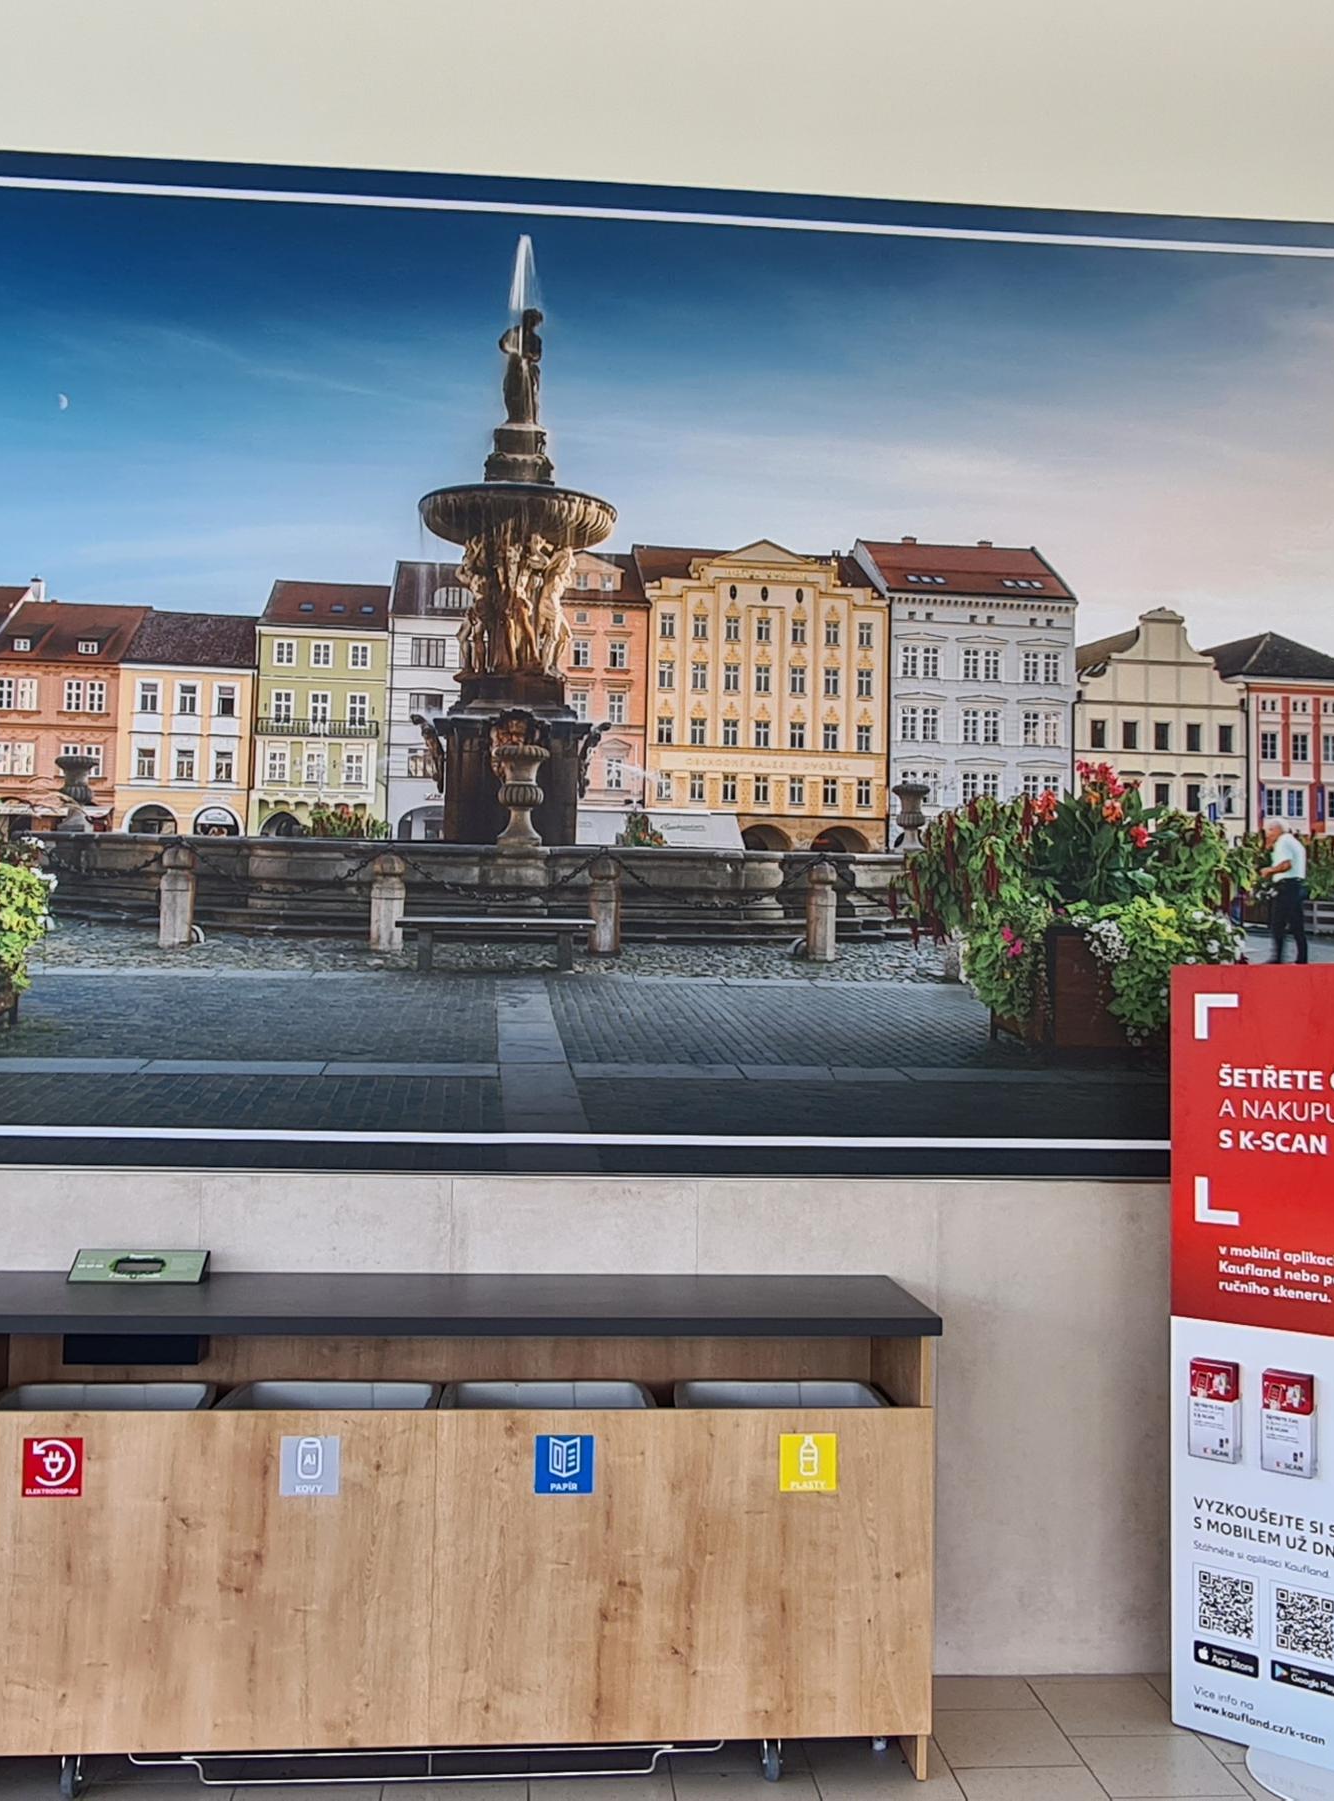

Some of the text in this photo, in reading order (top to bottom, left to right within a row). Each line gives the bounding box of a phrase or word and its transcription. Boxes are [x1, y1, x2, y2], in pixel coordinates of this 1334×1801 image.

[1219, 1063, 1324, 1091] ŠETŘETE
[1219, 1098, 1236, 1118] A
[1219, 1129, 1328, 1155] S K-SCAN
[1219, 1246, 1227, 1255] v
[1230, 1245, 1280, 1261] mobilní
[1218, 1260, 1281, 1279] Kaufland
[1284, 1269, 1319, 1283] nebo
[1219, 1280, 1331, 1303] ručního skeneru.
[295, 1484, 323, 1493] KOVY
[550, 1481, 577, 1491] PAPÍR
[1193, 1496, 1305, 1531] VYZKOUŠEJTE
[1309, 1520, 1323, 1535] SI
[1193, 1516, 1202, 1529] S
[1207, 1519, 1281, 1546] MOBILEM
[1286, 1535, 1307, 1552] UŽ
[1193, 1540, 1235, 1558] Stáhněte
[1237, 1551, 1244, 1559] si
[1247, 1553, 1282, 1568] aplikaci
[1211, 1654, 1254, 1673] App Store
[1290, 1673, 1319, 1689] Google
[1218, 1691, 1238, 1706] info
[1240, 1701, 1255, 1711] na
[1193, 1701, 1326, 1746] www.kaufland.cz/k-scan
